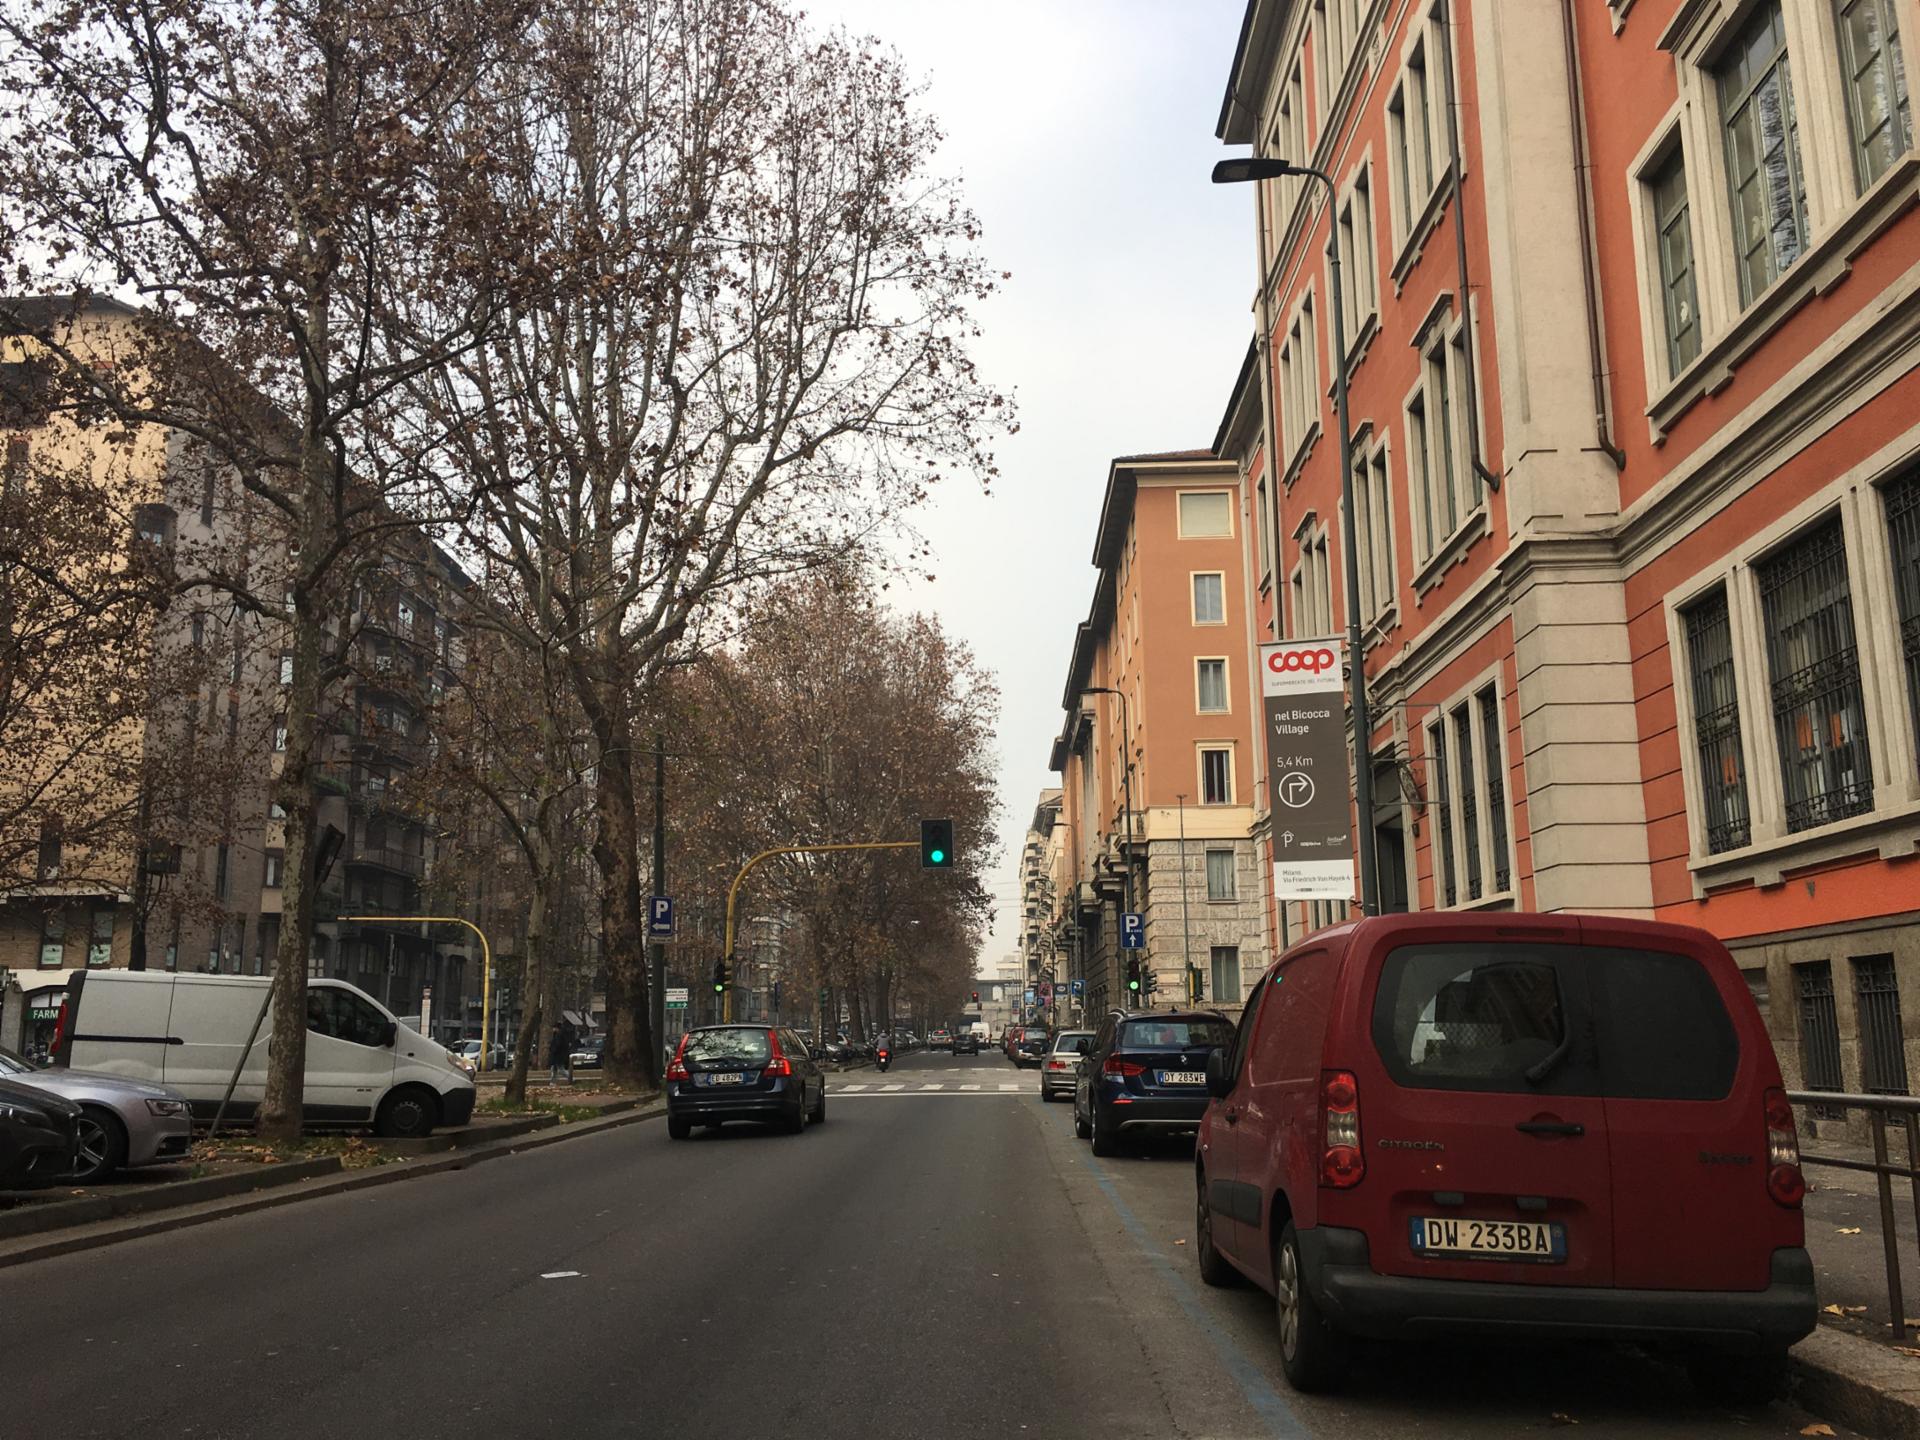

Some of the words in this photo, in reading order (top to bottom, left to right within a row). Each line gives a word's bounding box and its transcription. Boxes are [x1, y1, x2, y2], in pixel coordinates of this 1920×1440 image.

[1268, 648, 1335, 674] coop
[1275, 711, 1290, 721] nel
[1291, 710, 1330, 720] Bicocca
[1275, 724, 1309, 735] Village
[1277, 756, 1293, 768] 5,4
[1295, 756, 1313, 766] Km
[655, 900, 669, 919] P
[1125, 915, 1139, 933] P
[32, 1009, 59, 1019] FARM
[1470, 1223, 1548, 1251] 233BA
